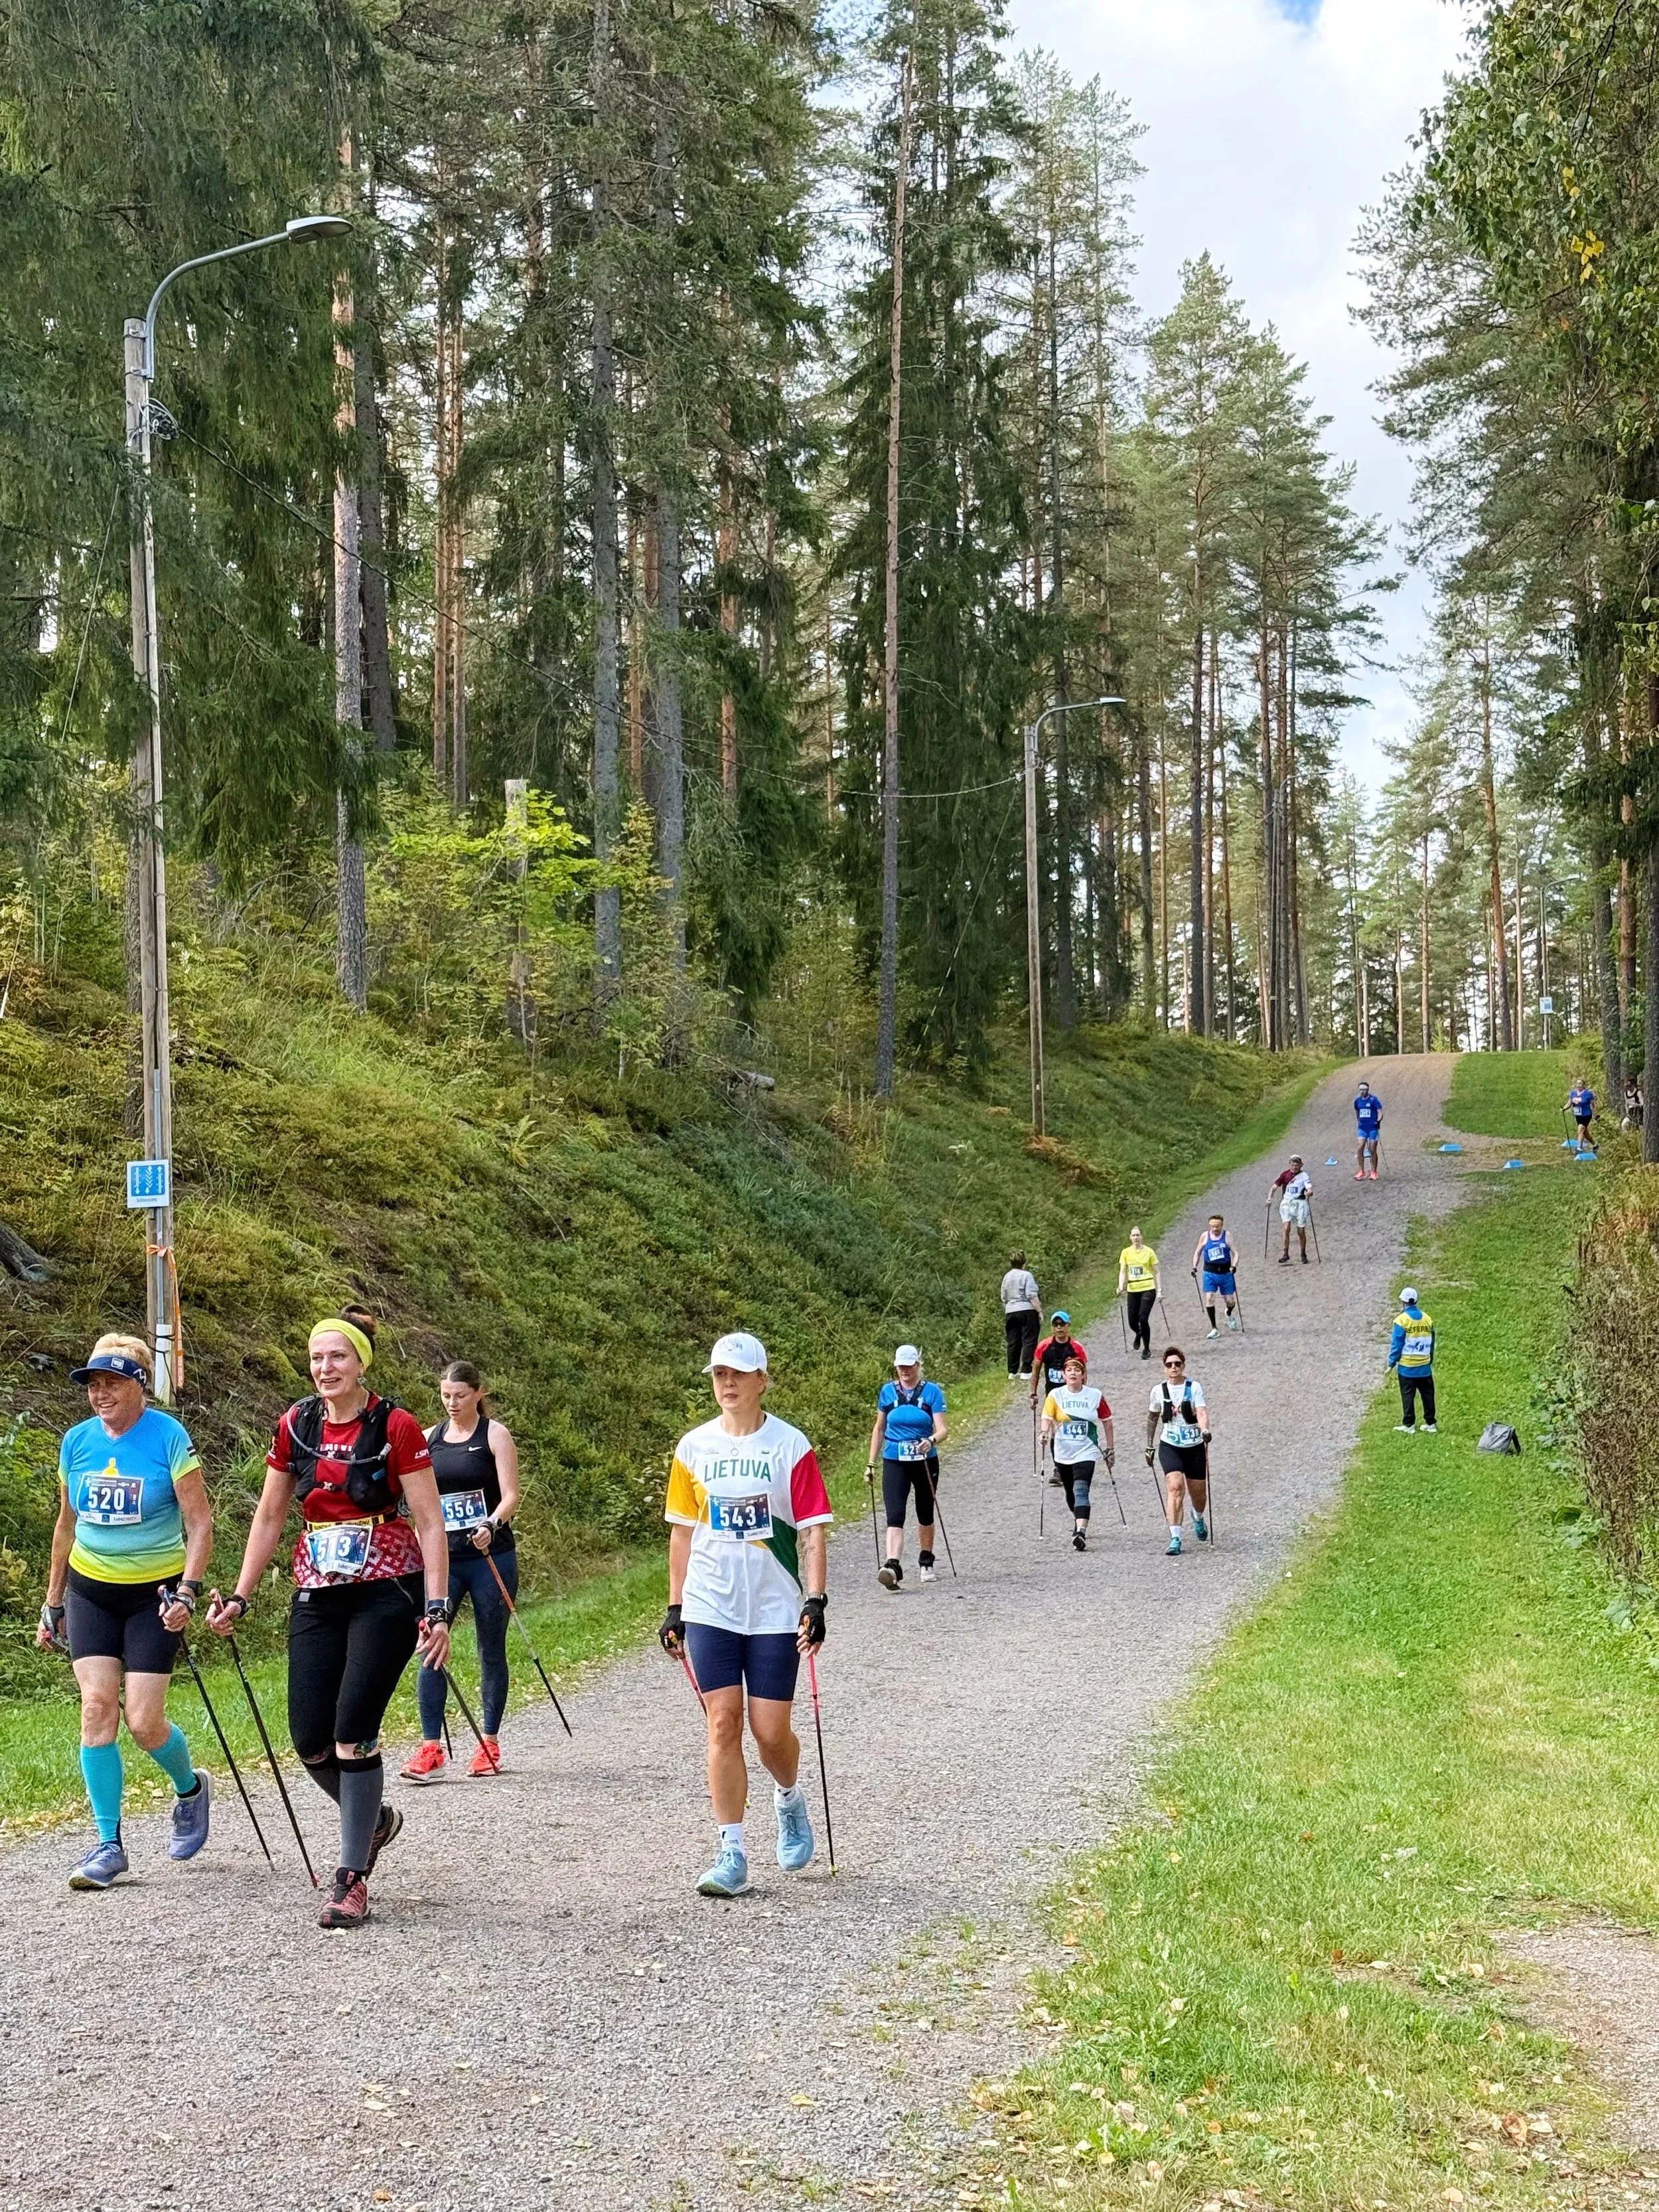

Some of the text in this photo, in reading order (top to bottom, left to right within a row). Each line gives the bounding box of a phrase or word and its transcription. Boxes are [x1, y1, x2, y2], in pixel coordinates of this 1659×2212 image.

[1062, 1400, 1090, 1409] LIETUVA
[1066, 1424, 1082, 1434] 544
[704, 1459, 772, 1483] LIETUVA
[88, 1486, 125, 1511] 520
[445, 1499, 474, 1519] 556
[719, 1505, 757, 1527] 543
[316, 1536, 352, 1564] 513
